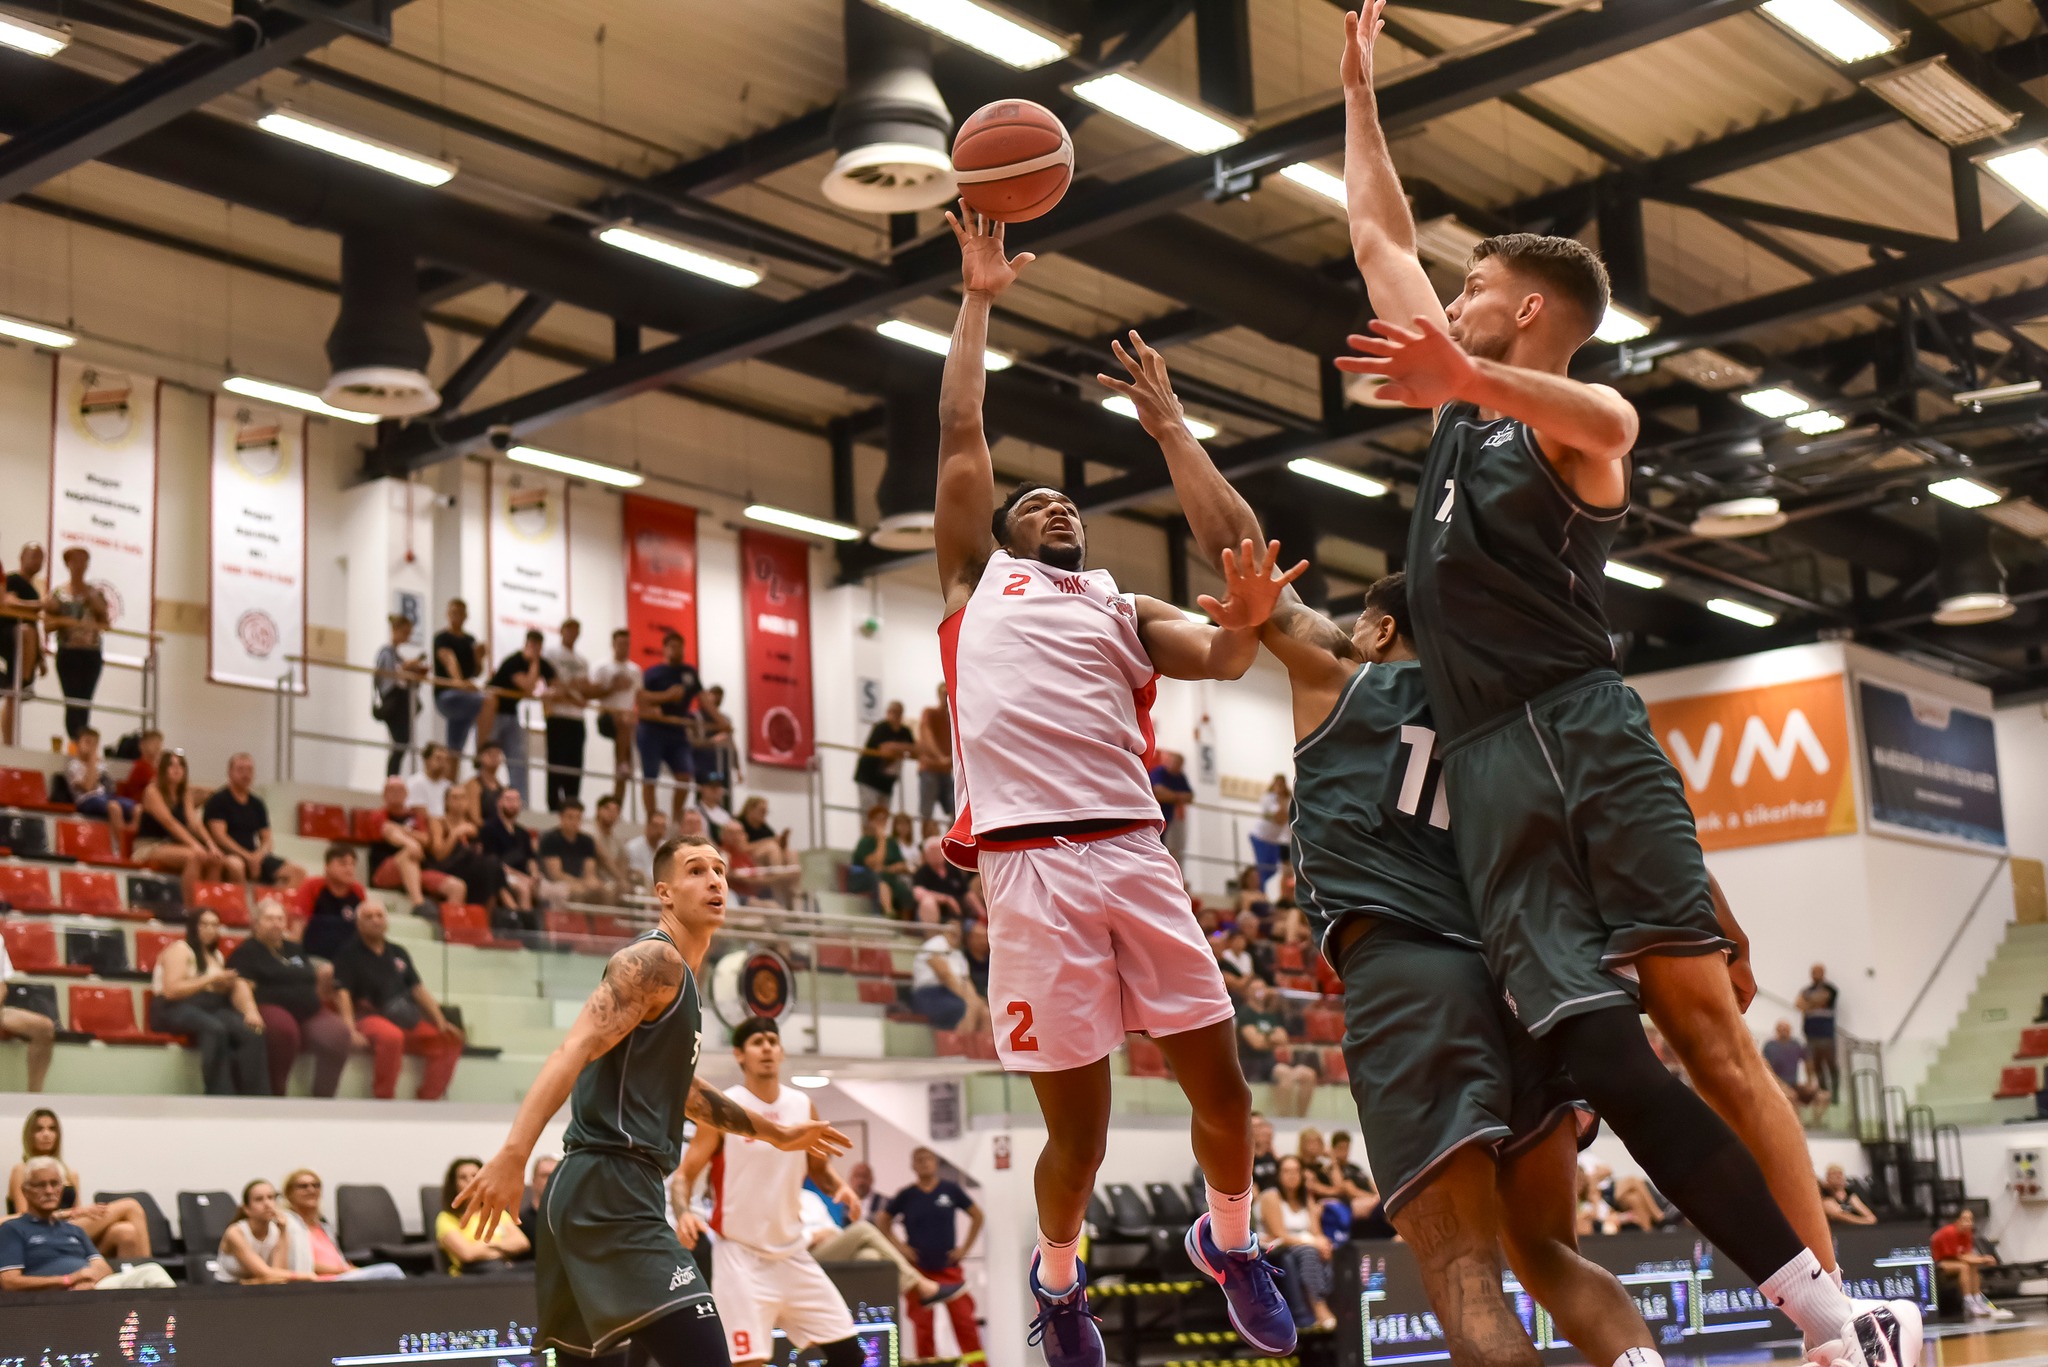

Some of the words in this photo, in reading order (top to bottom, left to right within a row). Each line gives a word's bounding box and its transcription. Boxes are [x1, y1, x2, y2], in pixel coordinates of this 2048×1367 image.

[1002, 573, 1032, 596] 2
[863, 680, 877, 709] S
[1726, 811, 1741, 830] a
[1743, 799, 1826, 828] sikerhez
[1007, 1001, 1039, 1052] 2
[733, 1330, 751, 1356] 9
